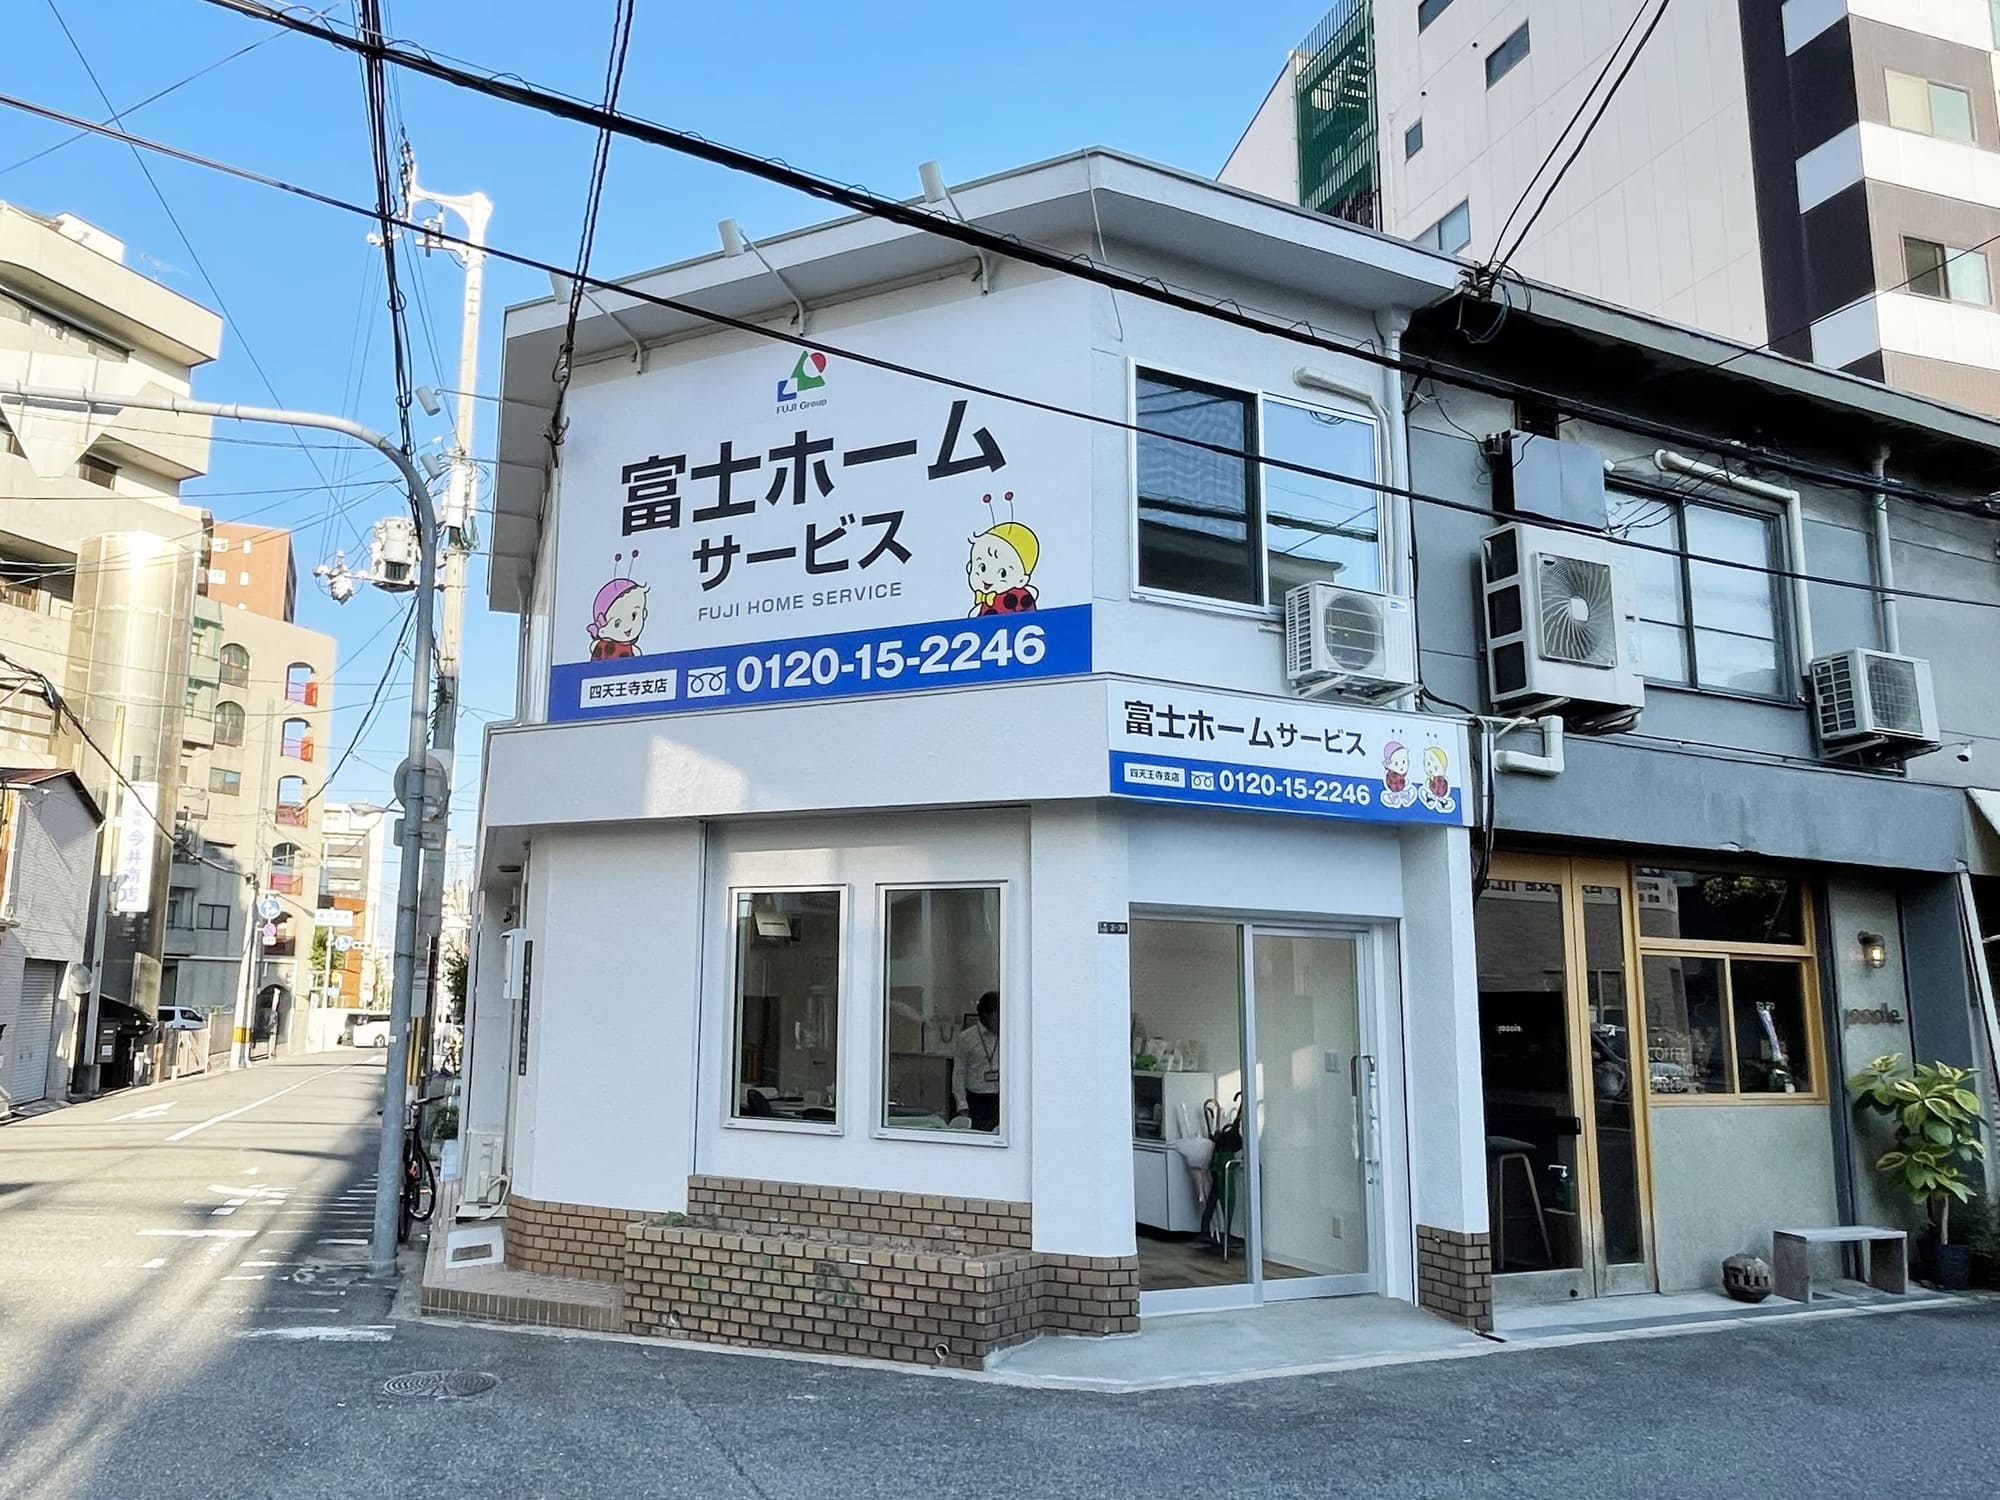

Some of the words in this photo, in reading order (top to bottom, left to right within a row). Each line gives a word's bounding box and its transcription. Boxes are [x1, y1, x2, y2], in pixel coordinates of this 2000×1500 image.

[621, 400, 1007, 536] 富士ホーム
[692, 510, 913, 592] サービス
[698, 603, 739, 621] FUJI
[747, 594, 804, 615] HOME
[812, 582, 902, 607] SERVICE
[736, 624, 1046, 692] 0120-15-2246
[589, 678, 668, 700] 四天王寺支店
[1123, 700, 1367, 757] 富士ホームサービス
[1219, 769, 1371, 806] 0120-15-2246
